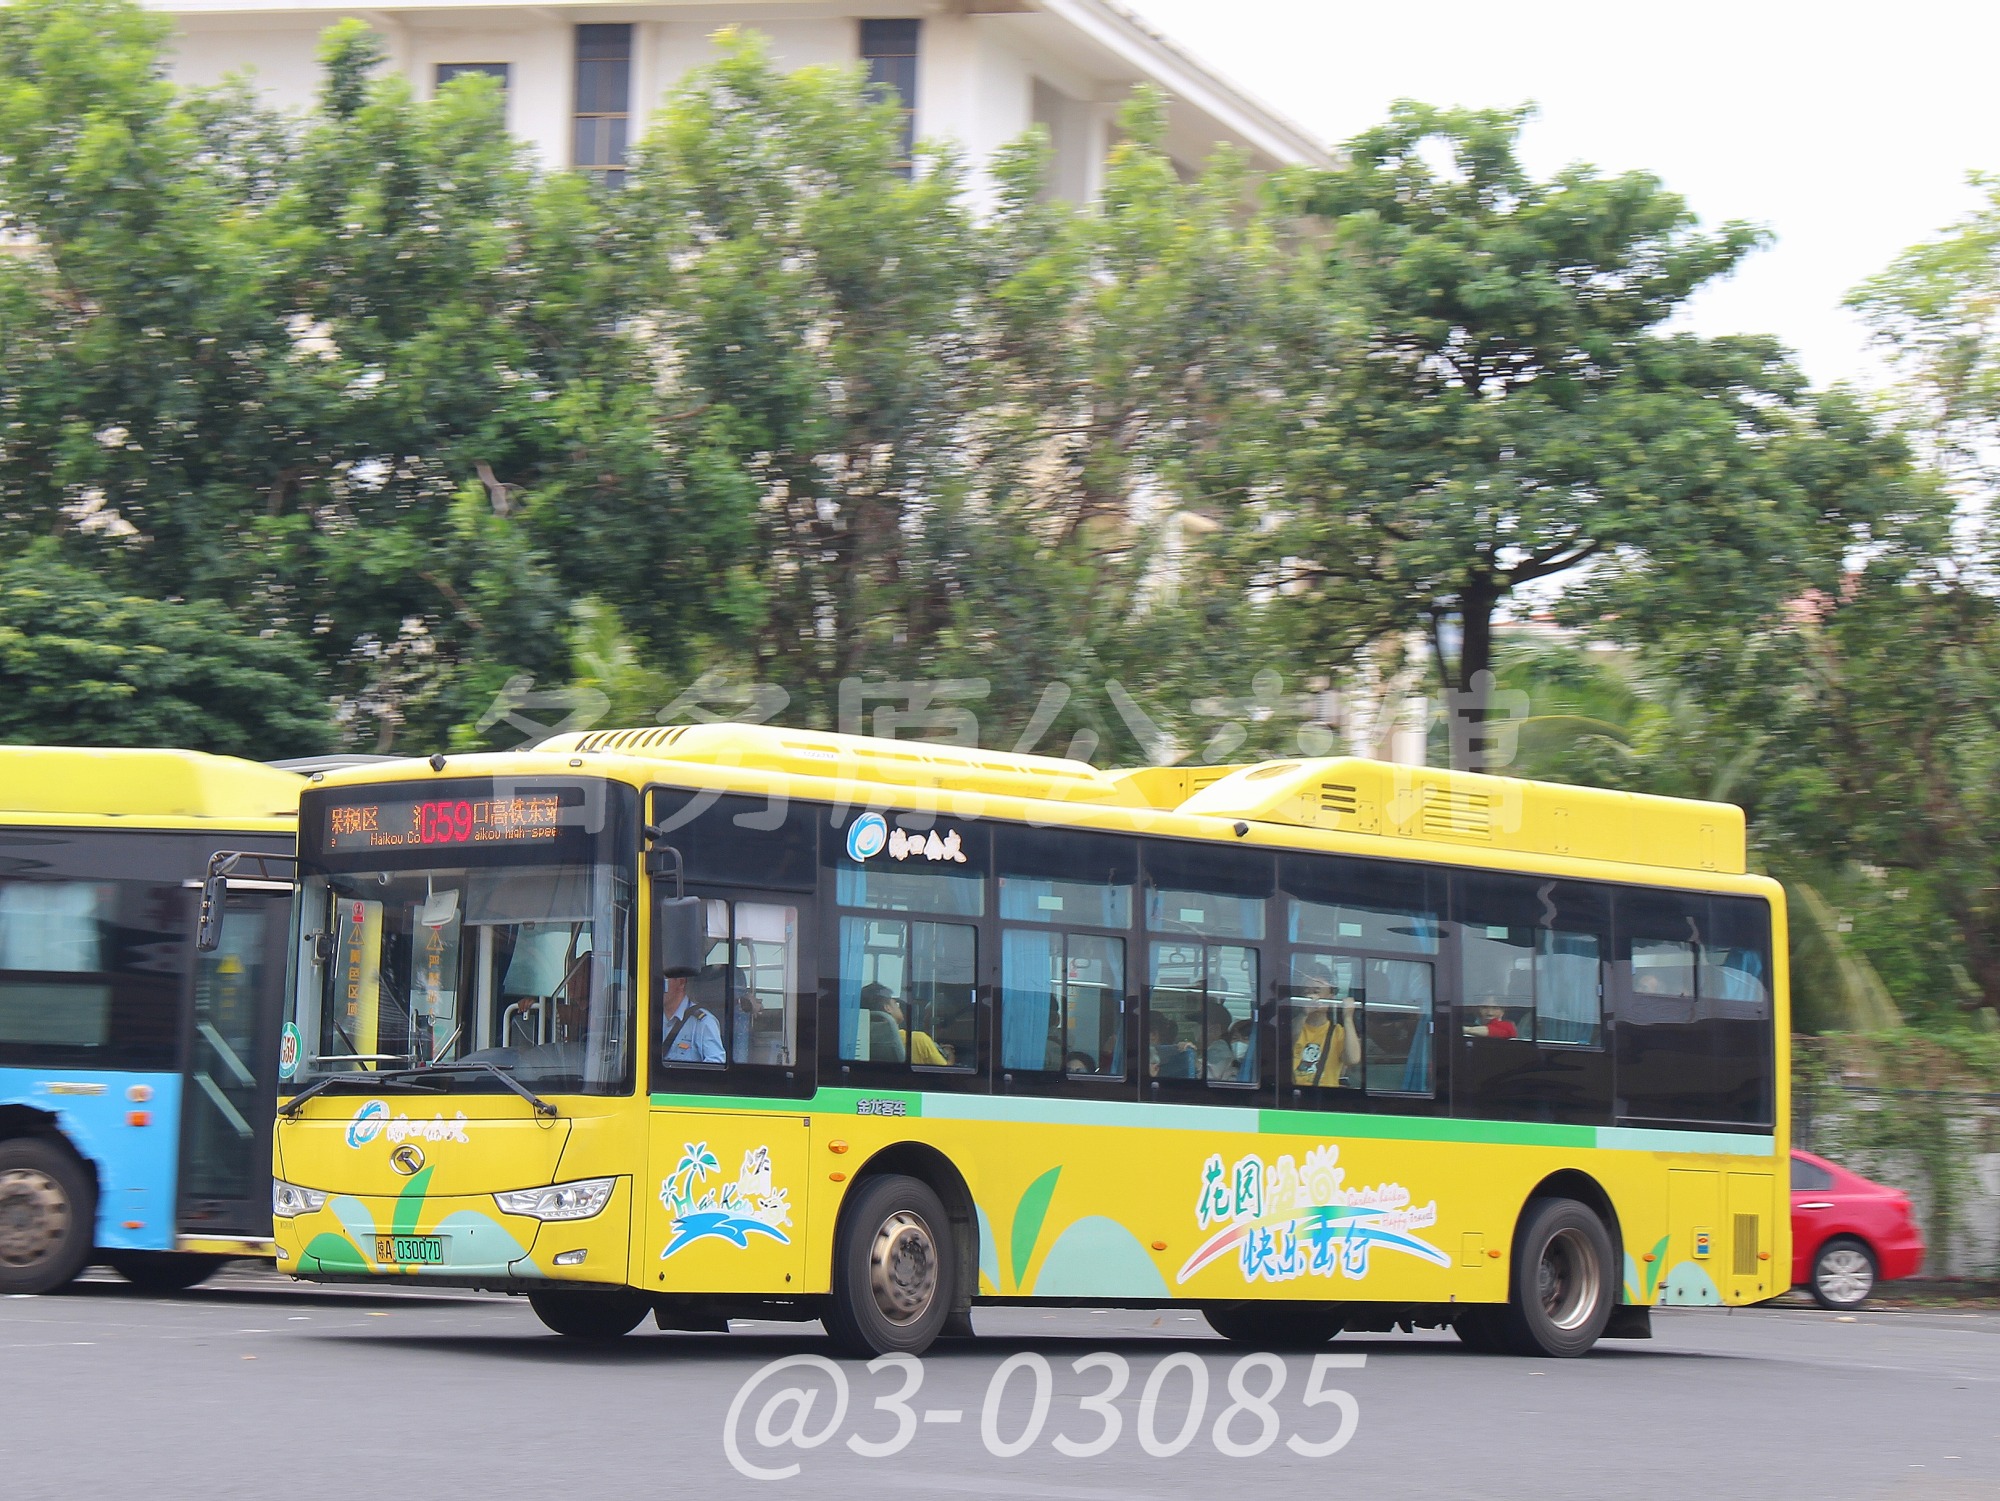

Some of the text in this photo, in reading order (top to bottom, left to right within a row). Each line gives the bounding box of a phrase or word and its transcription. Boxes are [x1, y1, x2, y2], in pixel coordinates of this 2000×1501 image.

[421, 800, 473, 844] G59
[370, 832, 403, 846] Haikou
[474, 826, 501, 841] aikou
[857, 1098, 906, 1117] 金龙客车
